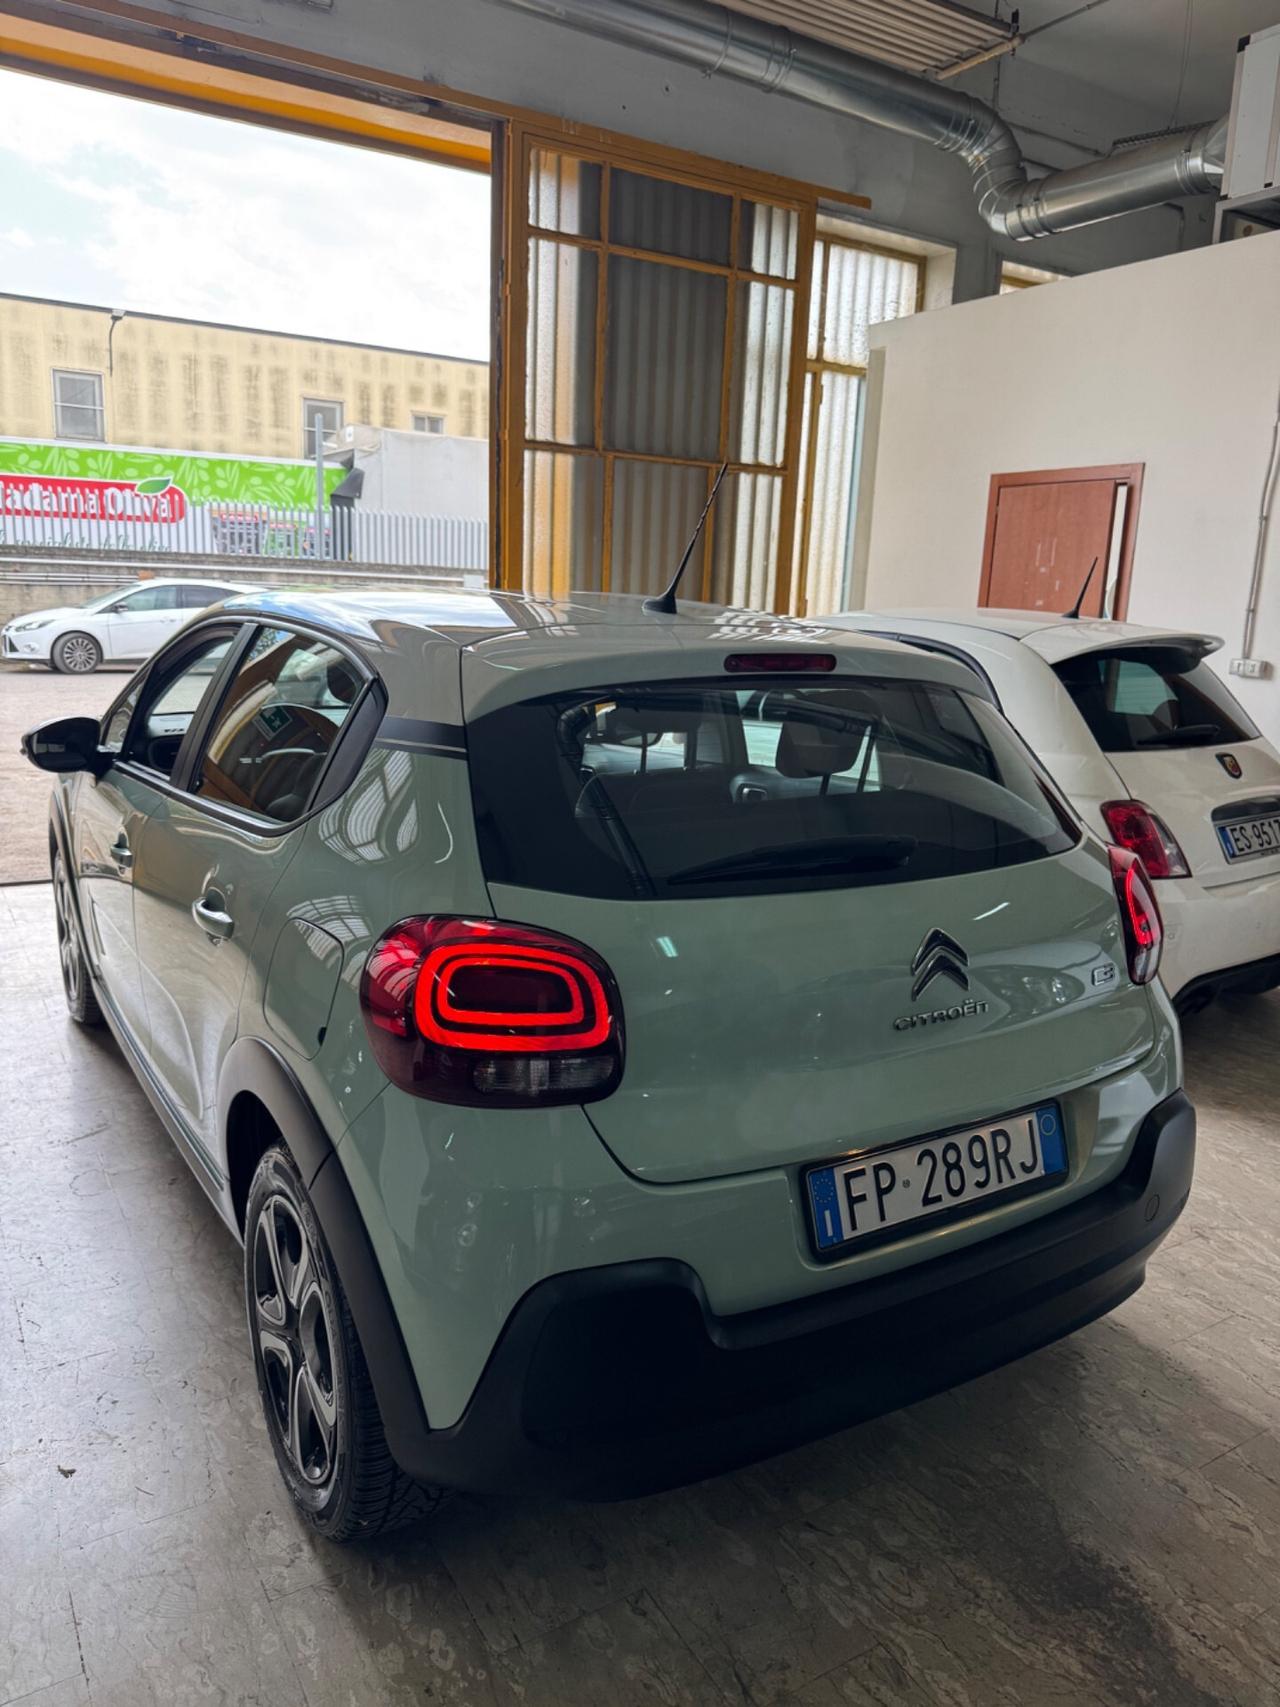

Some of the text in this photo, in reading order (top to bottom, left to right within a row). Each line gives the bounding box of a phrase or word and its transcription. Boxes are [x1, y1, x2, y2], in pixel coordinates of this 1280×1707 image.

[893, 999, 989, 1031] CITROËN
[843, 1119, 1038, 1231] FP 289RJ
